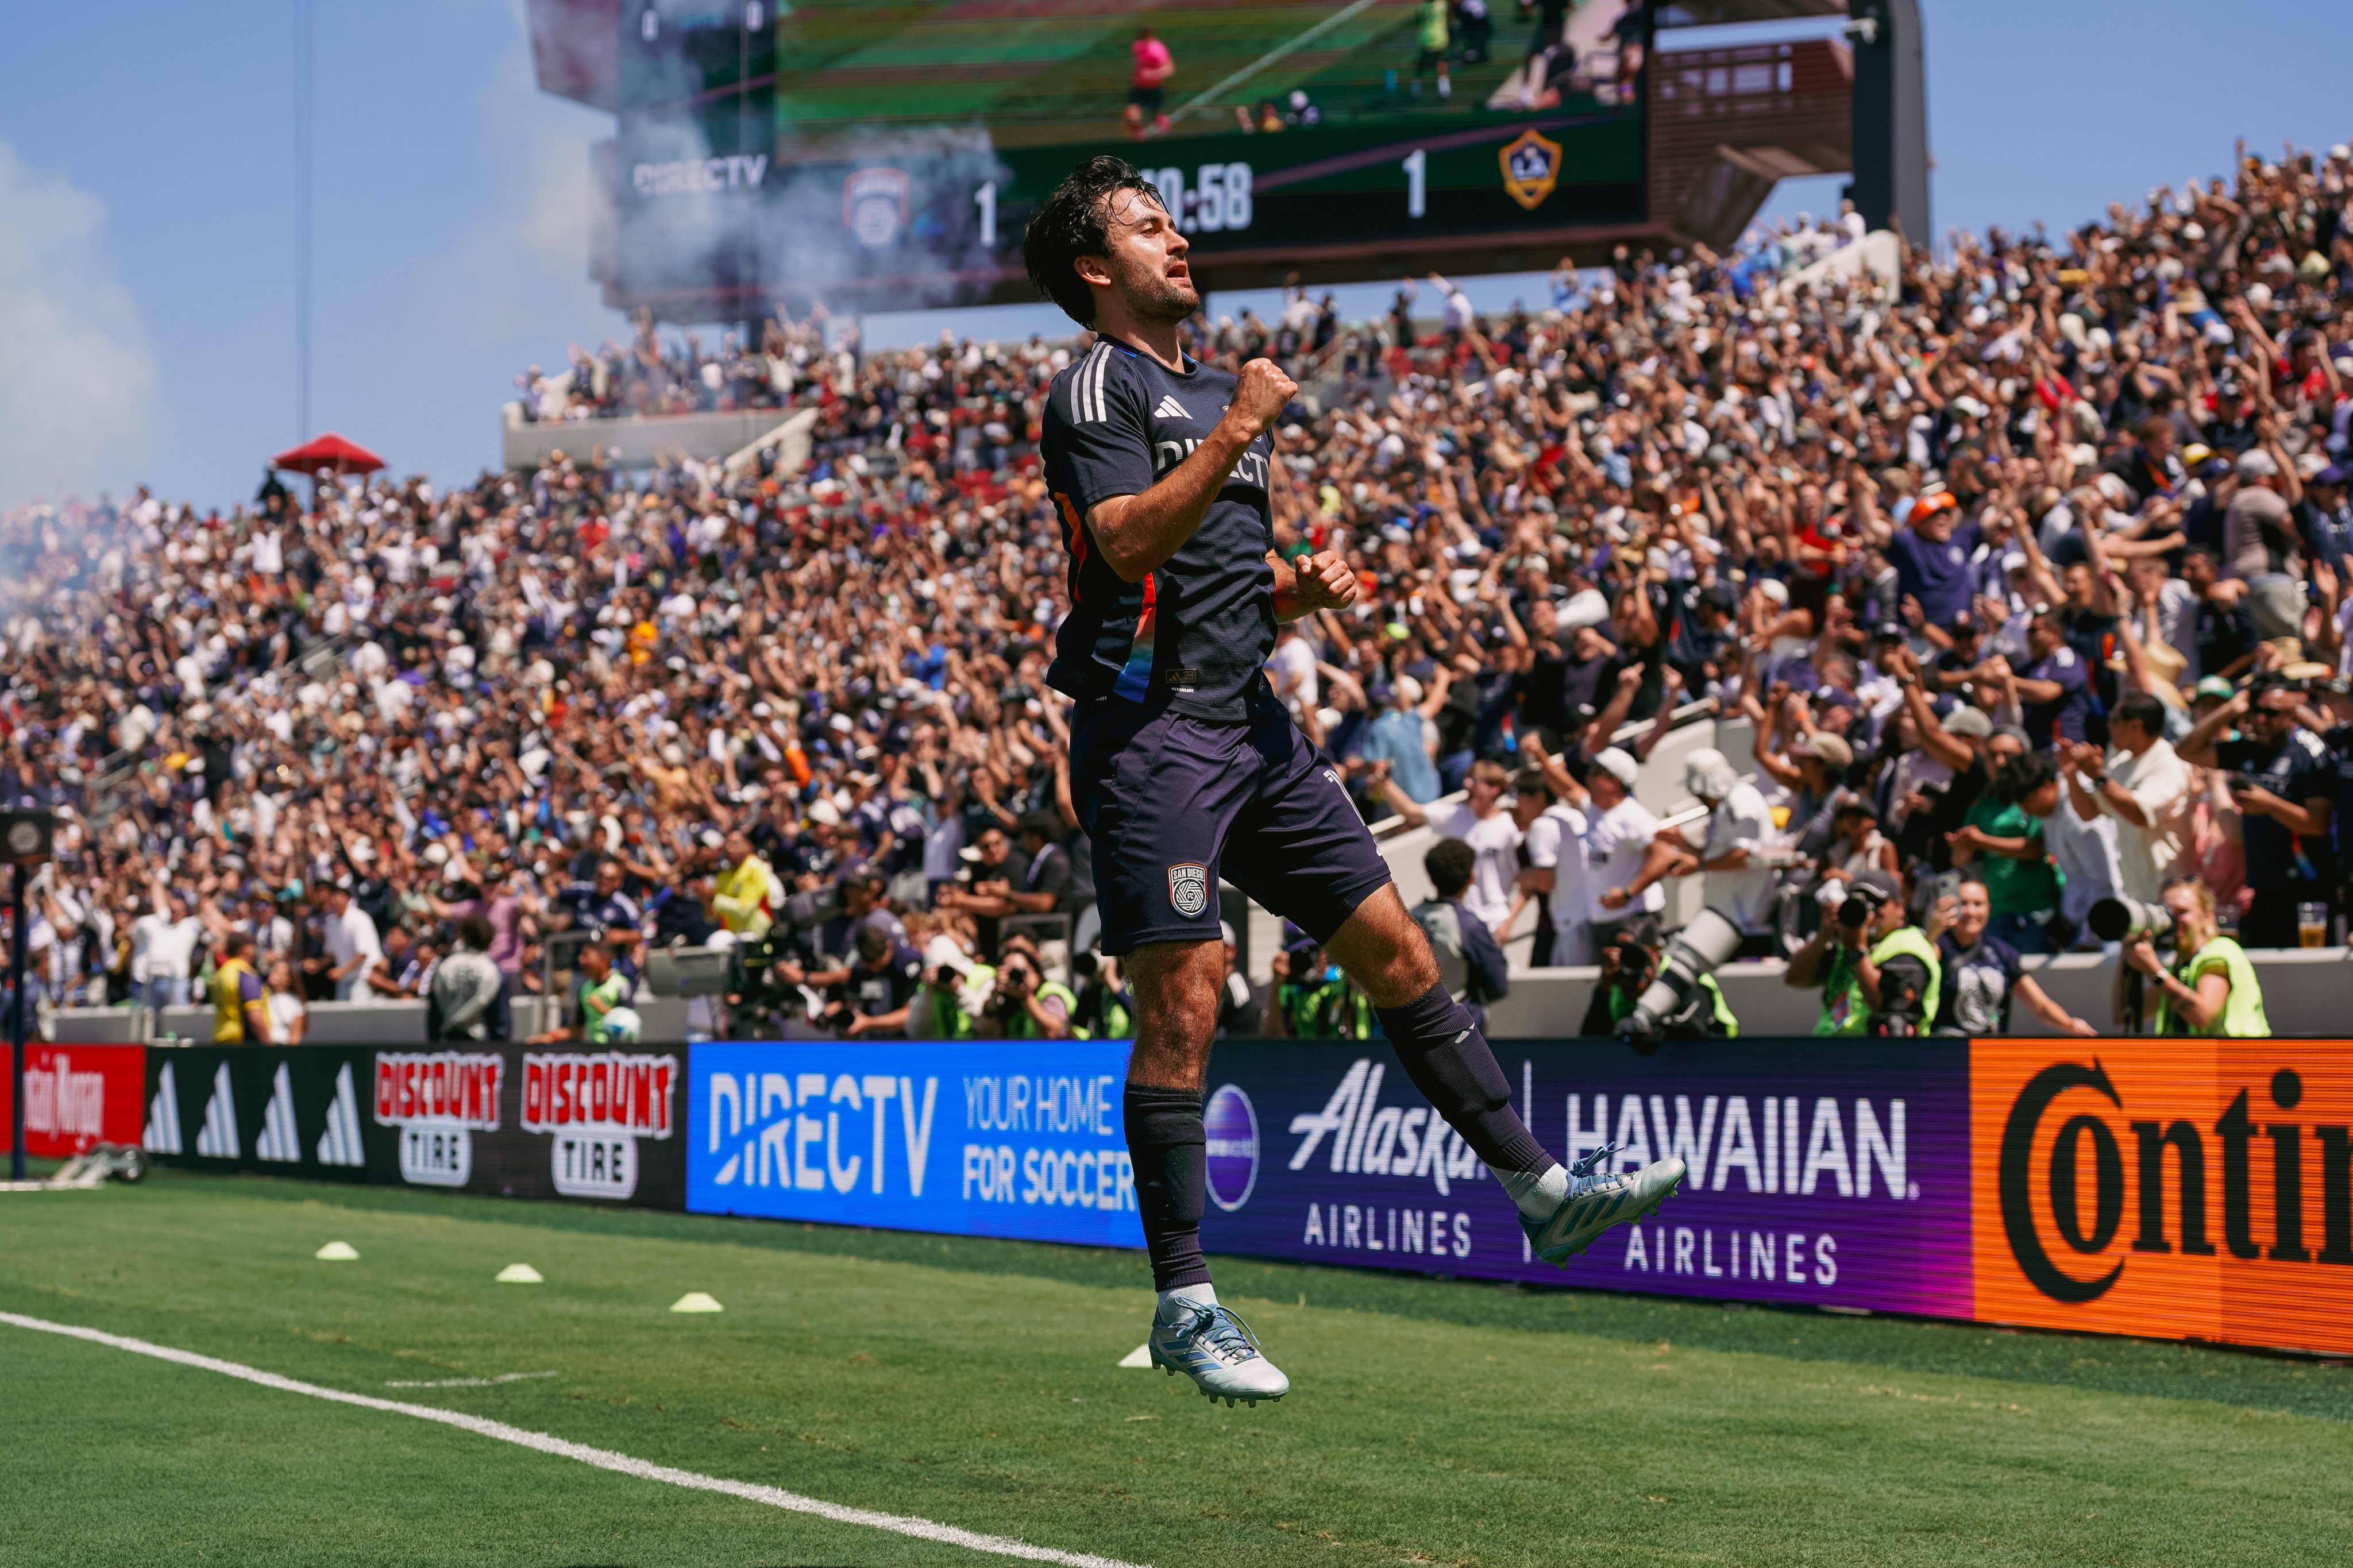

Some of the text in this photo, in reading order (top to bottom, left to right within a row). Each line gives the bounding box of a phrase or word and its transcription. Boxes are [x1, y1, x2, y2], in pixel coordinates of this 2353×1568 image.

[974, 180, 997, 247] 1
[1140, 161, 1253, 233] 0:58
[1402, 148, 1426, 219] 1
[1173, 868, 1203, 880] SAN DIEGO
[376, 1058, 501, 1126] DISCOUNT
[524, 1058, 673, 1133] DISCOUNT
[963, 1076, 1114, 1136] YOUR HOME
[409, 1133, 460, 1171] TIRE
[564, 1140, 623, 1183] TIRE
[709, 1072, 938, 1198] DIRECTV
[1566, 1093, 1907, 1200] HAWAIIAN
[963, 1144, 1136, 1211] FOR SOCCER
[1303, 1202, 1472, 1258] AIRLINES
[1623, 1225, 1838, 1287] AIRLINES
